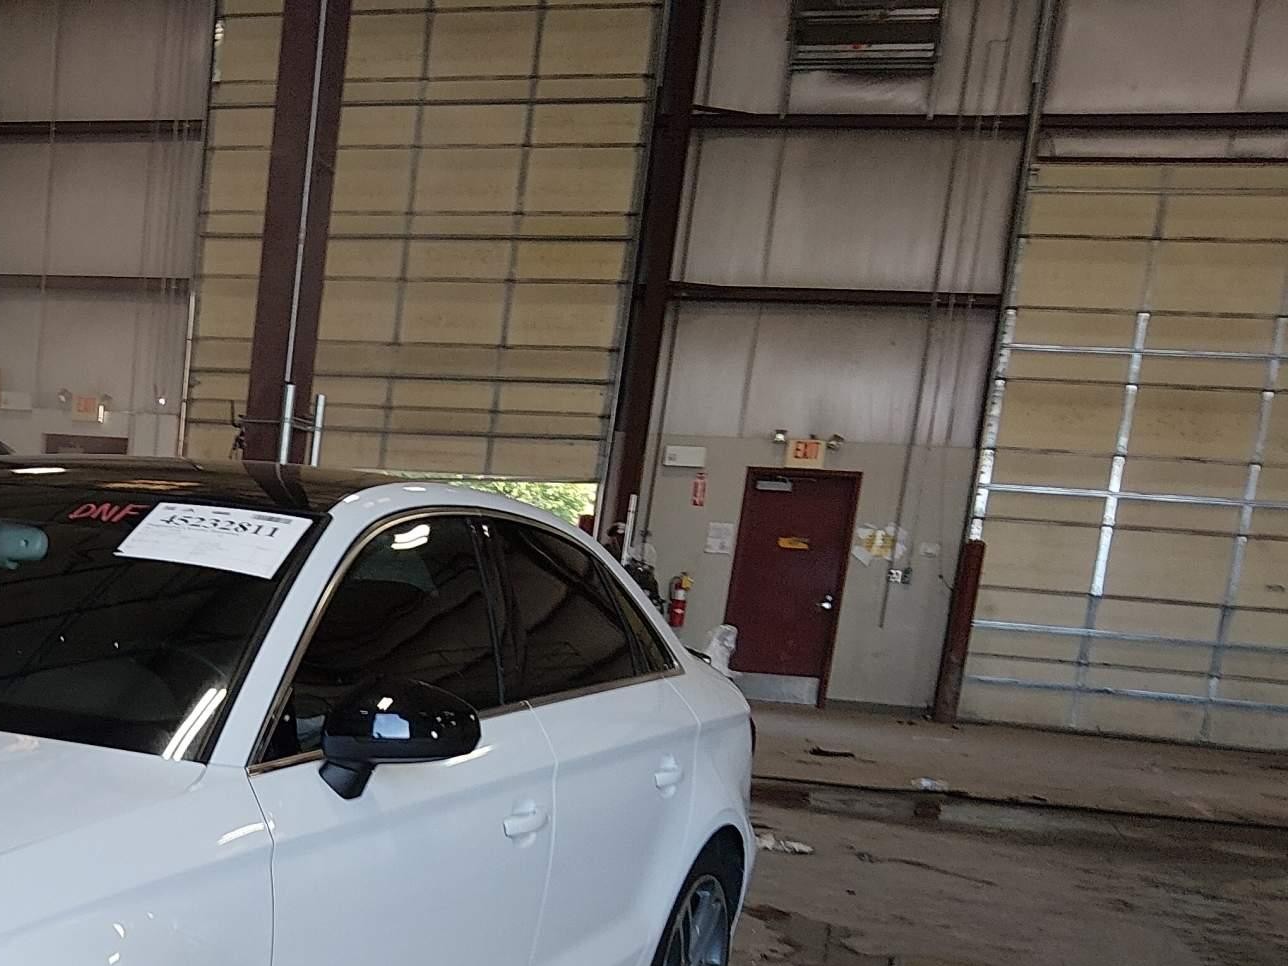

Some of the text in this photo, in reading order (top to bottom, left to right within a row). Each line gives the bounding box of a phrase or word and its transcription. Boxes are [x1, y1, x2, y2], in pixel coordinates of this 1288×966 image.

[794, 441, 820, 459] EXIT
[68, 503, 150, 522] DNF
[160, 515, 279, 538] 45232811
